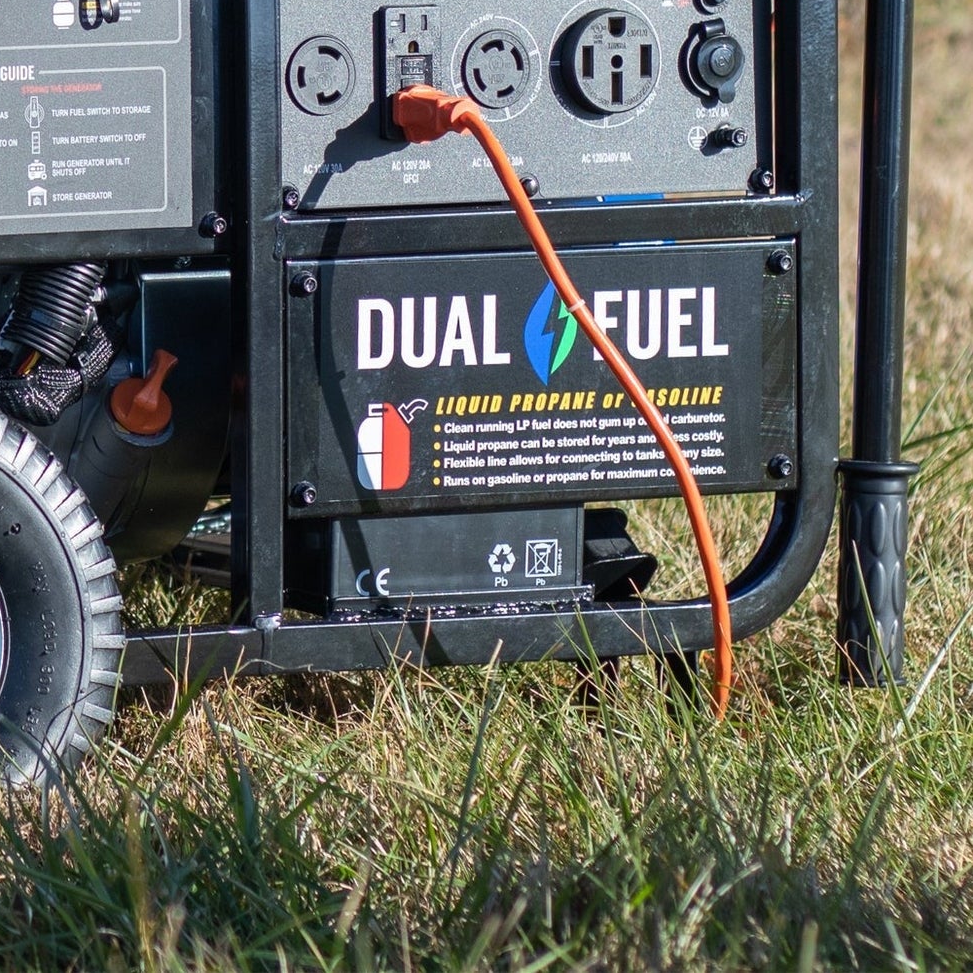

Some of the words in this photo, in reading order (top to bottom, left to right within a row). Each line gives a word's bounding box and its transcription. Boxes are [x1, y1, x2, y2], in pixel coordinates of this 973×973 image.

[0, 65, 35, 81] GUIDE
[52, 108, 69, 117] TURN
[70, 107, 86, 116] FUEL
[87, 107, 111, 116] SWITCH
[112, 106, 121, 115] TO
[122, 105, 151, 115] STORAGE
[52, 136, 69, 145] TURN
[70, 135, 98, 144] BATTERY
[99, 134, 124, 143] SWITCH
[124, 134, 133, 142] TO
[134, 133, 146, 142] OFF
[52, 160, 65, 168] RUN
[66, 158, 104, 167] GENERATOR
[105, 157, 123, 166] UNTIL
[124, 157, 130, 165] IT
[303, 164, 313, 174] AC
[313, 163, 329, 173] 120V
[330, 163, 343, 173] 30A
[391, 161, 401, 170] AC
[402, 160, 418, 170] 120V
[419, 159, 431, 169] 20A
[52, 168, 72, 176] SHUTS
[74, 167, 87, 176] OFF
[403, 174, 420, 184] GFCI
[52, 193, 73, 202] STORE
[74, 191, 112, 201] GENERATOR
[357, 295, 511, 370] DUAL
[592, 286, 729, 361] FUEL
[435, 394, 503, 416] LIQUID
[509, 391, 596, 413] PROPANE
[602, 393, 624, 409] or
[631, 386, 724, 408] ASOLINE
[444, 422, 474, 433] Clean
[475, 421, 514, 433] running
[516, 419, 530, 430] LP
[531, 418, 551, 430] fuel
[553, 418, 578, 429] does
[579, 417, 597, 428] not
[598, 418, 621, 429] gum
[623, 418, 636, 428] up
[671, 412, 726, 425] carburetor.
[444, 440, 475, 454] Liquid
[477, 440, 519, 453] propane
[521, 440, 540, 449] can
[542, 437, 555, 448] be
[557, 435, 590, 447] stored
[591, 435, 606, 446] for
[607, 435, 635, 447] years
[671, 432, 690, 442] ess
[691, 430, 724, 443] costly.
[444, 457, 486, 468] Flexible
[487, 456, 507, 467] line
[508, 455, 543, 466] allows
[545, 453, 560, 464] for
[562, 451, 620, 464] connecting
[622, 450, 633, 461] to
[635, 449, 665, 460] tanks
[681, 448, 699, 460] any
[701, 446, 724, 457] size.
[443, 476, 470, 486] Runs
[472, 476, 486, 485] on
[487, 473, 531, 487] gasoline
[533, 473, 545, 482] or
[546, 472, 589, 484] propane
[590, 469, 605, 479] for
[607, 467, 658, 479] maximum
[356, 567, 390, 596] CE
[494, 576, 509, 587] Pb
[535, 578, 546, 586] Pb
[40, 608, 58, 654] LOAD
